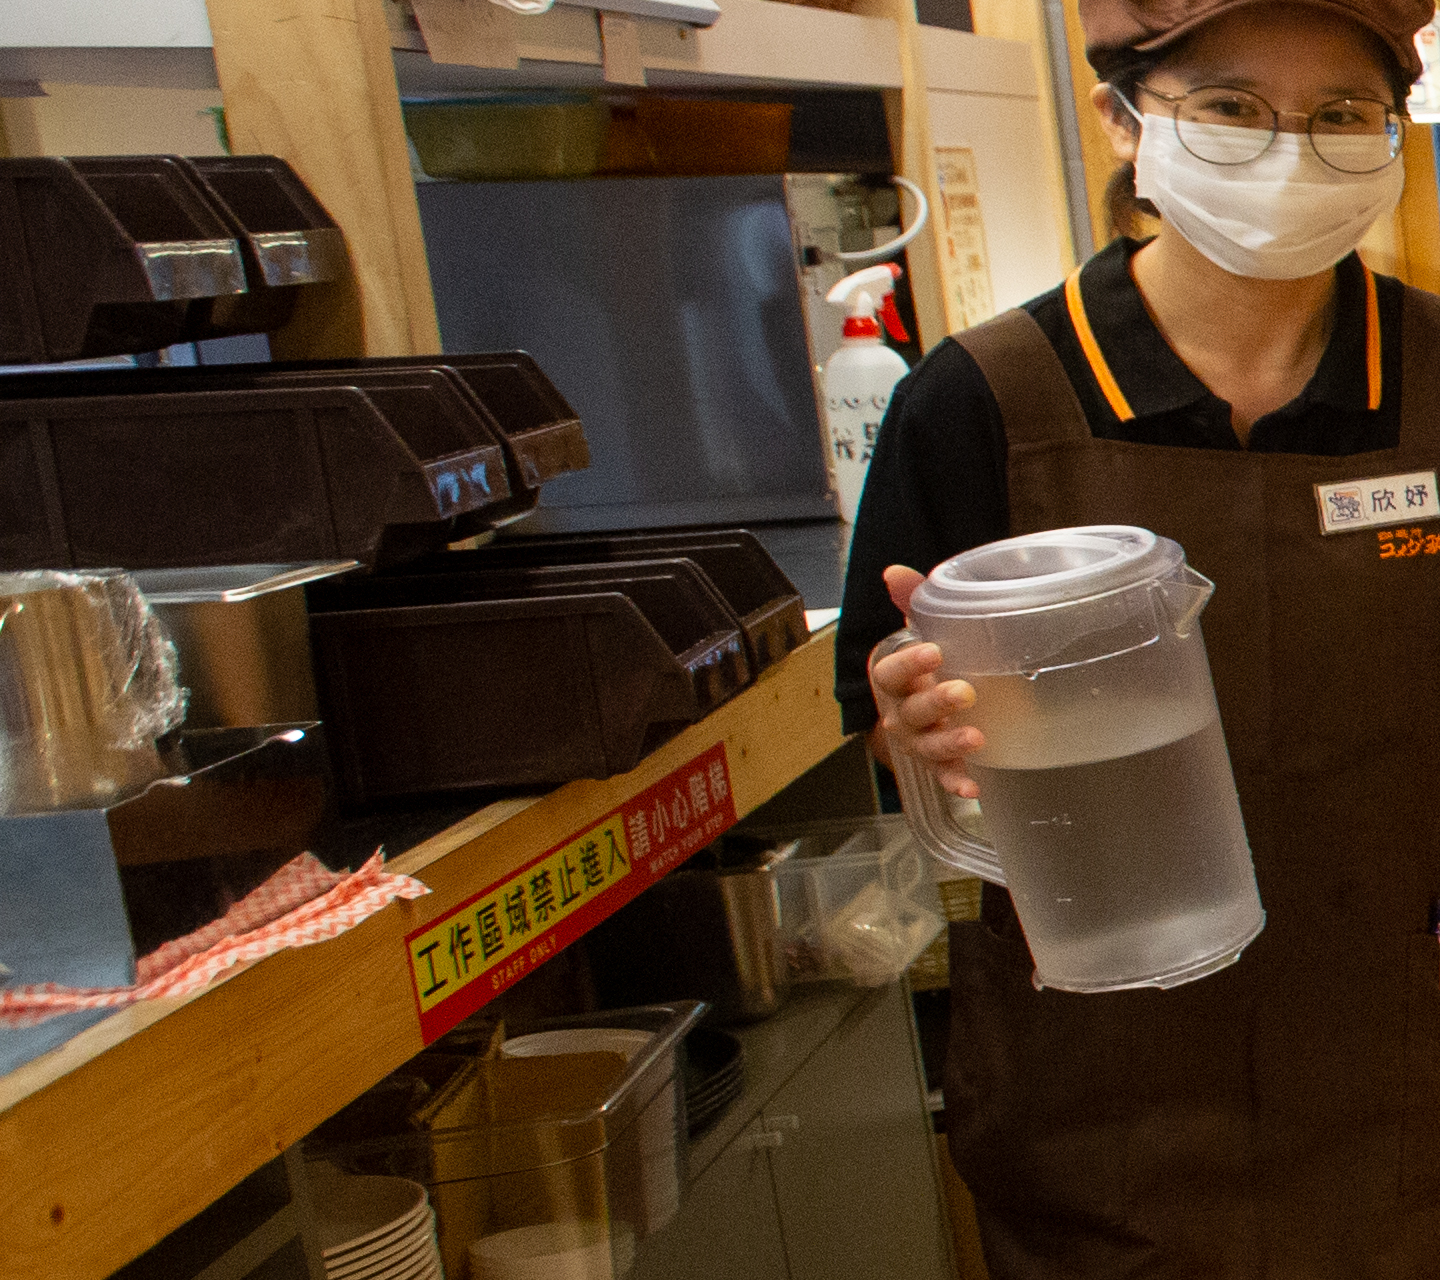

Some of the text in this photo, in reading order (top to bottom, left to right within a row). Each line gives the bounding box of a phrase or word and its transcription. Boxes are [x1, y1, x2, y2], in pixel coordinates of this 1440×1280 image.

[416, 829, 628, 998] 工作區域禁止進入
[490, 934, 558, 991] STAFF ONLY
